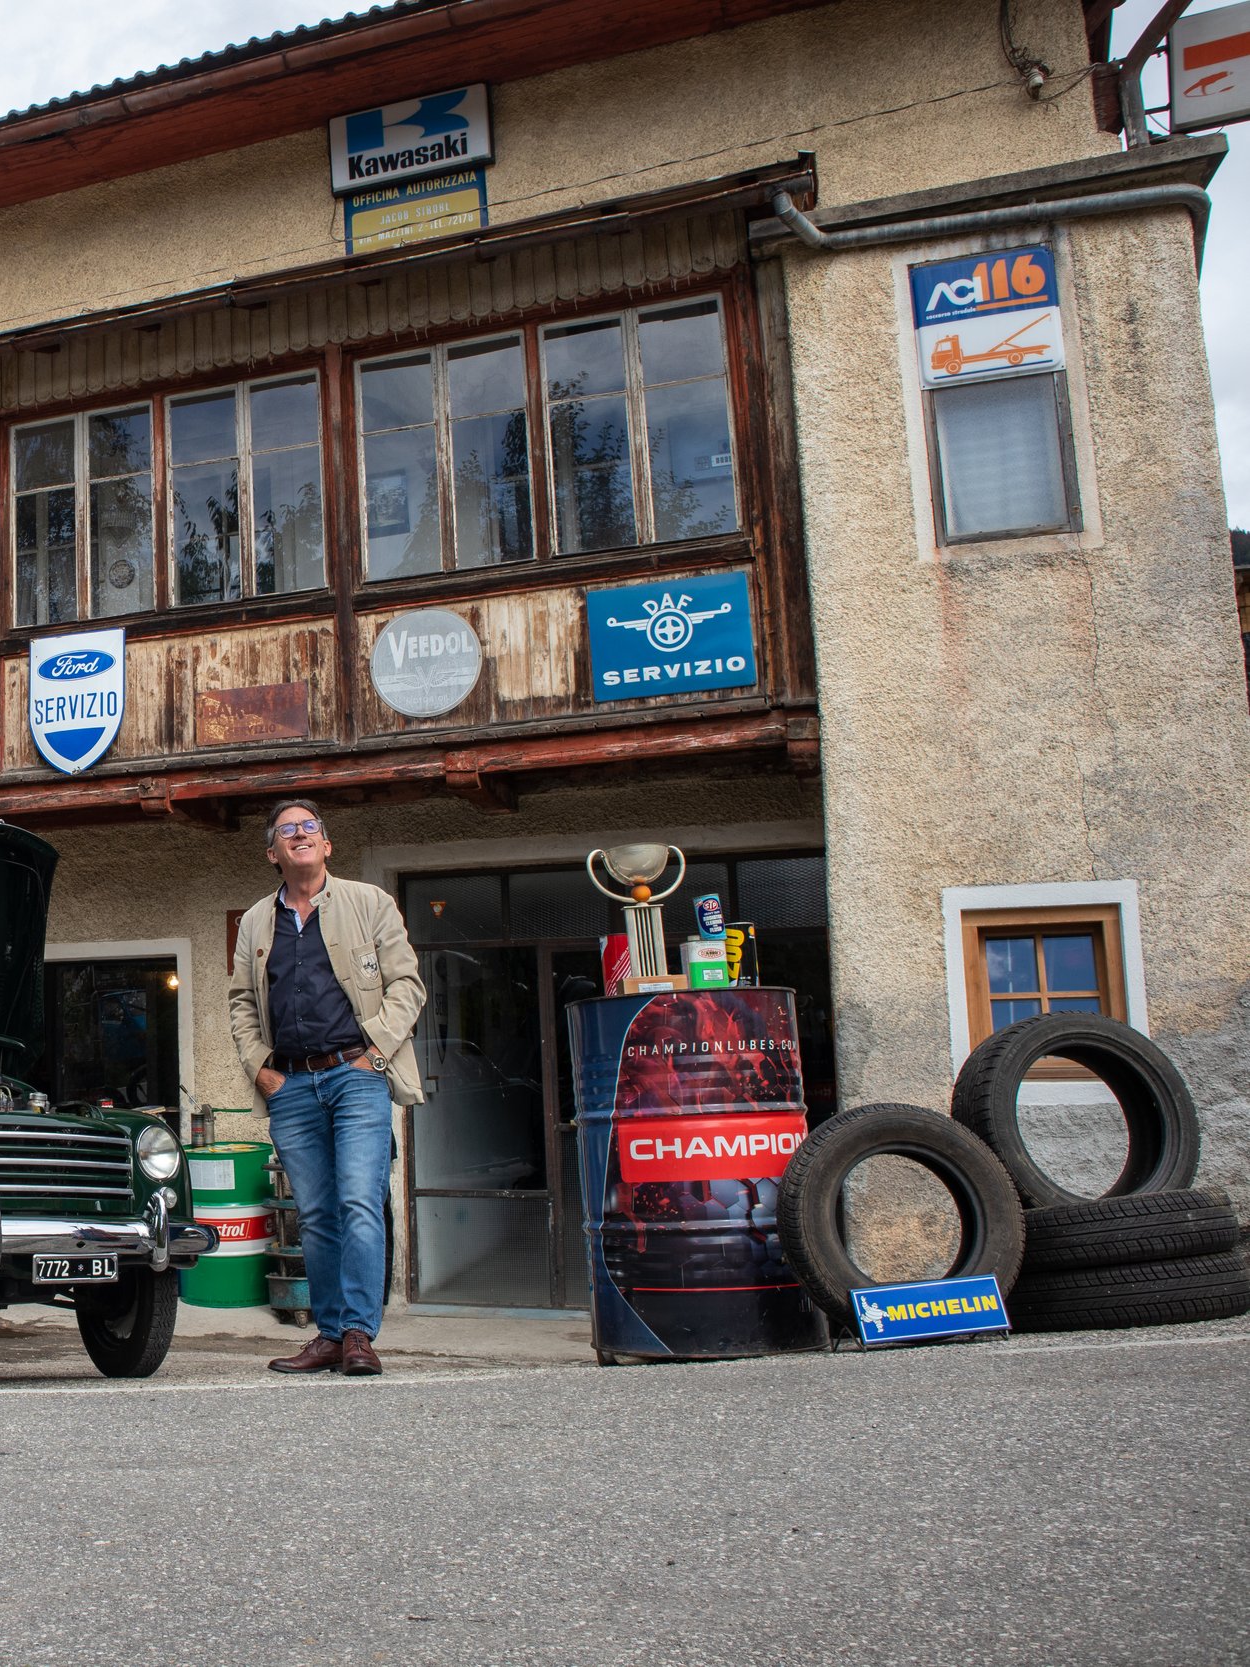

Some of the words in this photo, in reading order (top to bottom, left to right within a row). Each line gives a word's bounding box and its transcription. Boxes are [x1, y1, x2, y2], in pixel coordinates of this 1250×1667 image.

[348, 132, 468, 180] Kawasaki
[352, 187, 400, 207] OFFICINA
[406, 171, 477, 196] AUTORIZZATA
[973, 254, 1046, 301] 116
[642, 593, 693, 616] DAF
[387, 630, 474, 669] VEEDOL
[51, 653, 100, 677] Ford
[602, 656, 746, 686] SERVIZIO
[34, 691, 118, 726] SERVIZIO
[216, 1222, 246, 1237] strol
[38, 1260, 70, 1277] 7772
[92, 1258, 113, 1276] BL
[886, 1293, 999, 1321] MICHELIN
